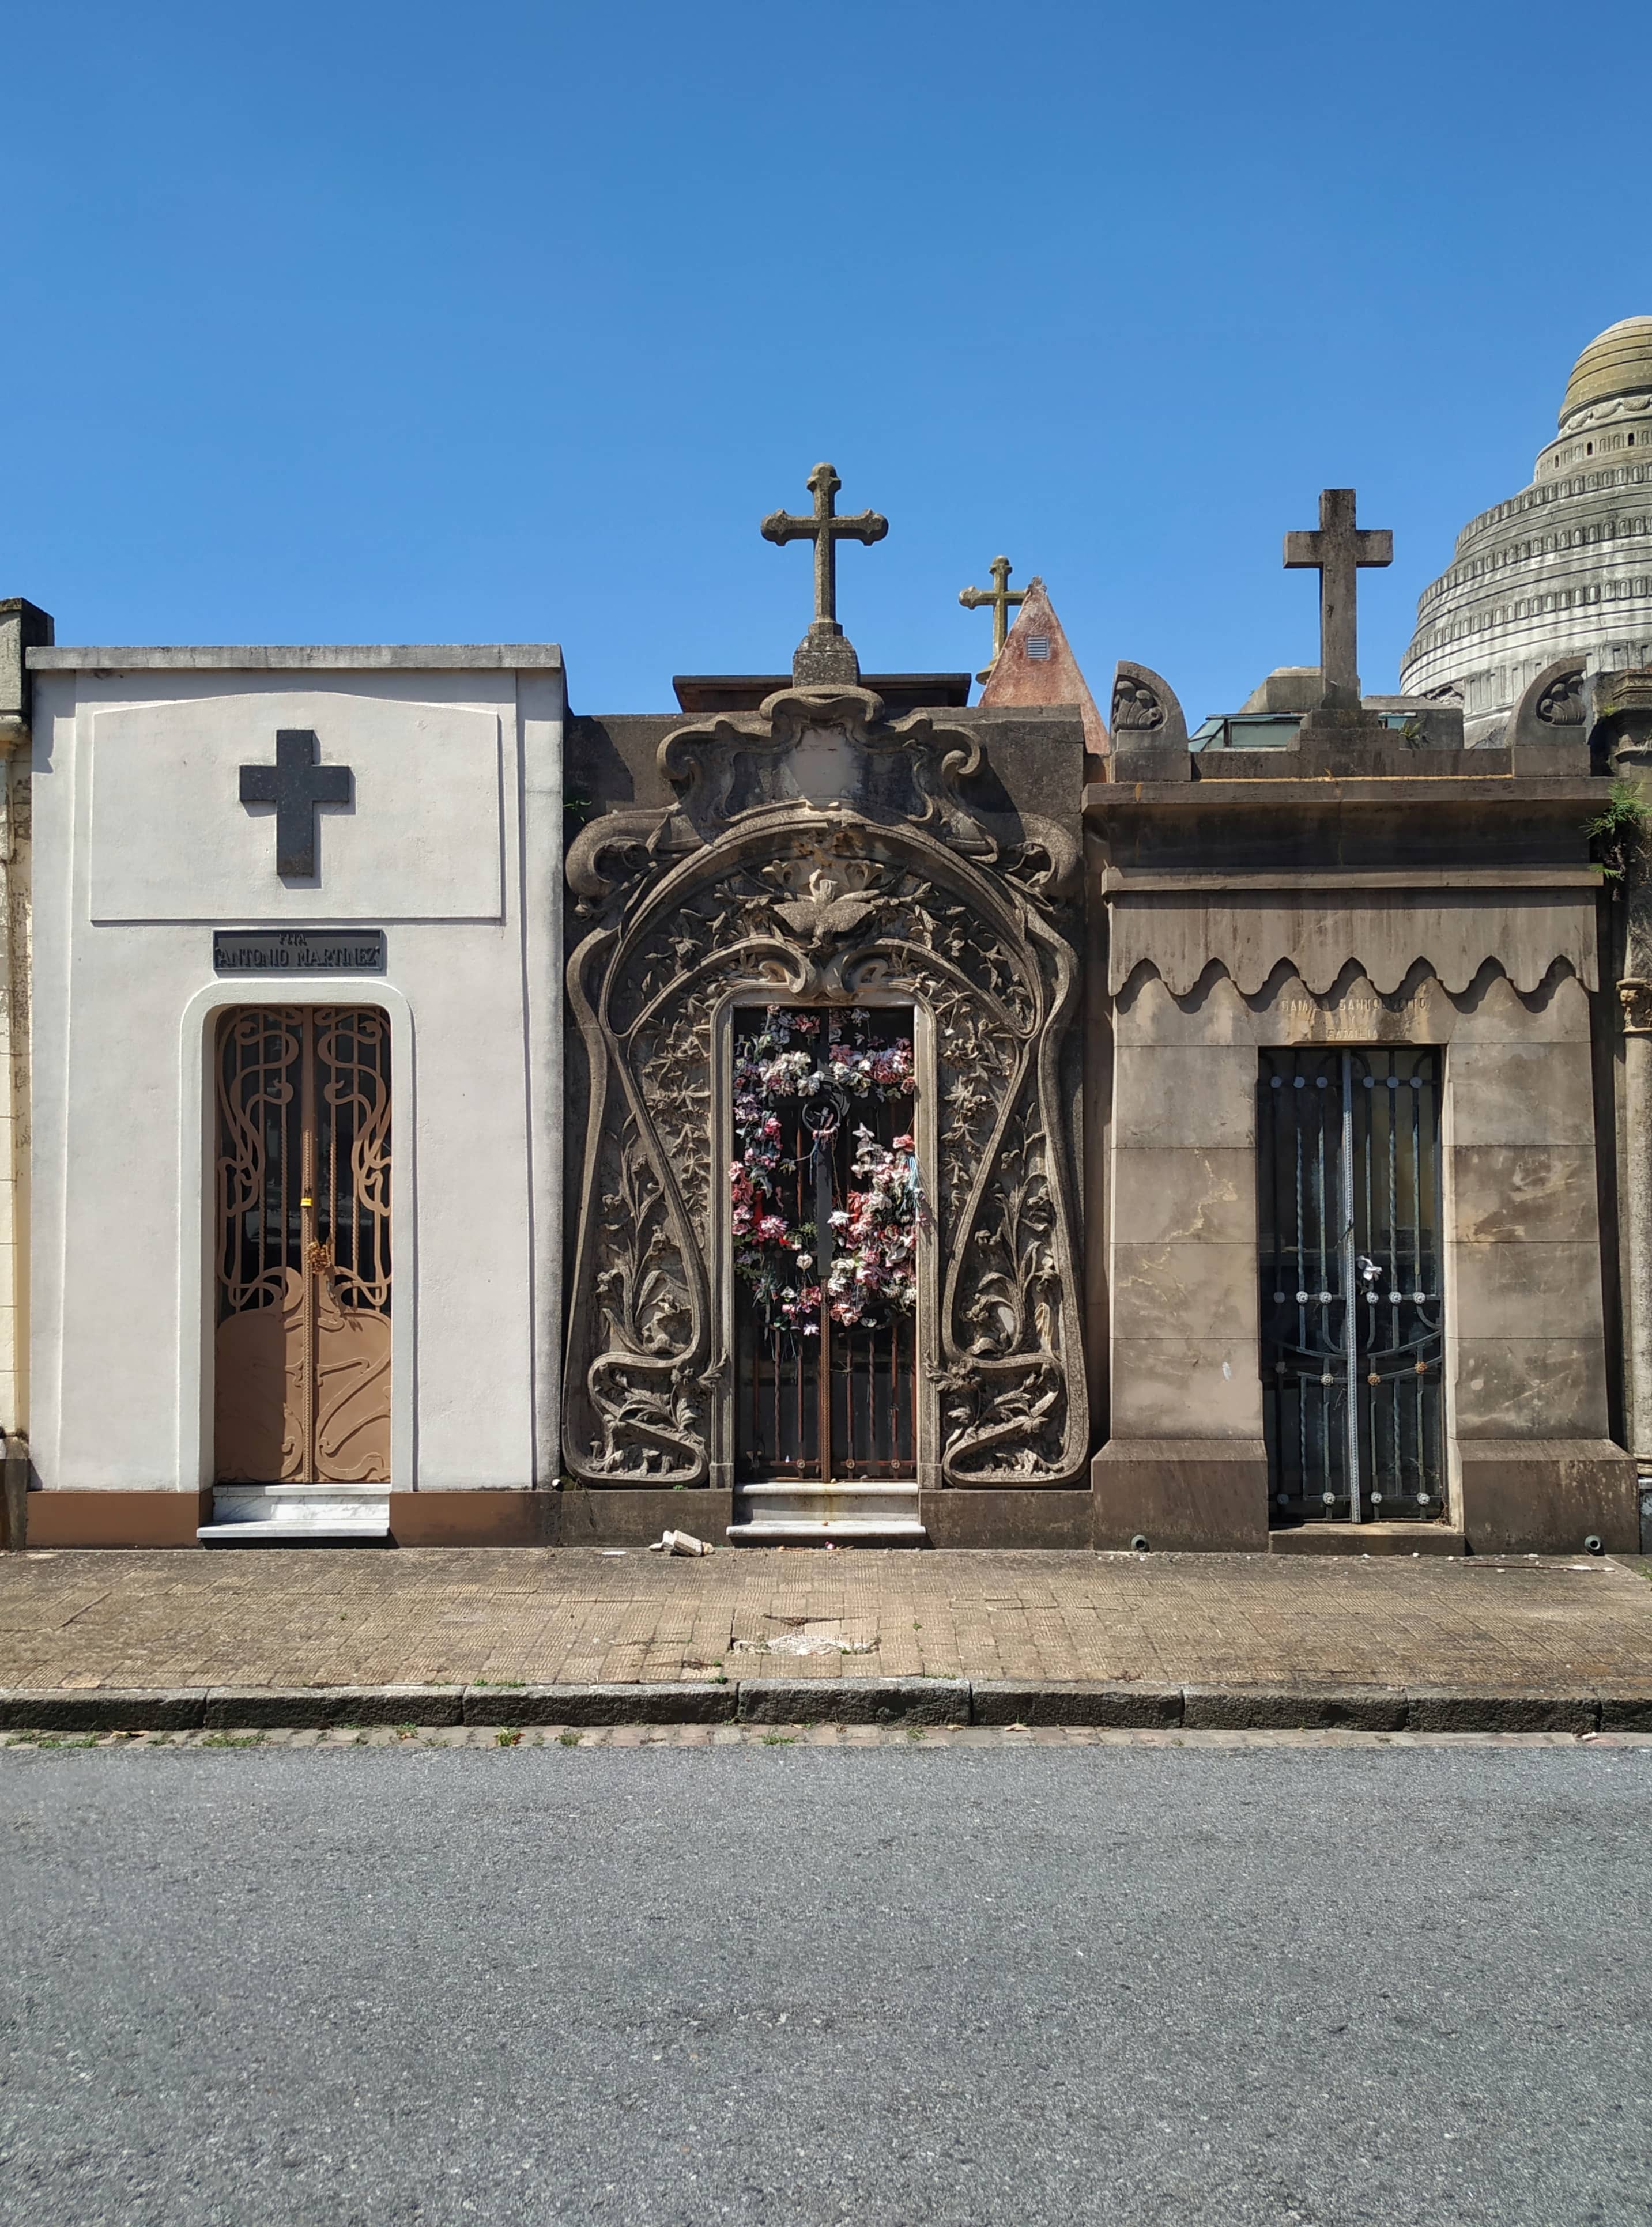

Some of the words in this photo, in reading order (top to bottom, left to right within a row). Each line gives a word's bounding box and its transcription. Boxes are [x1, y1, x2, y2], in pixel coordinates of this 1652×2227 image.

[218, 948, 289, 967] ANTONIO
[297, 948, 379, 967] MARTINEZ
[1348, 1014, 1356, 1024] Y
[1327, 1028, 1378, 1039] FAMILIA
